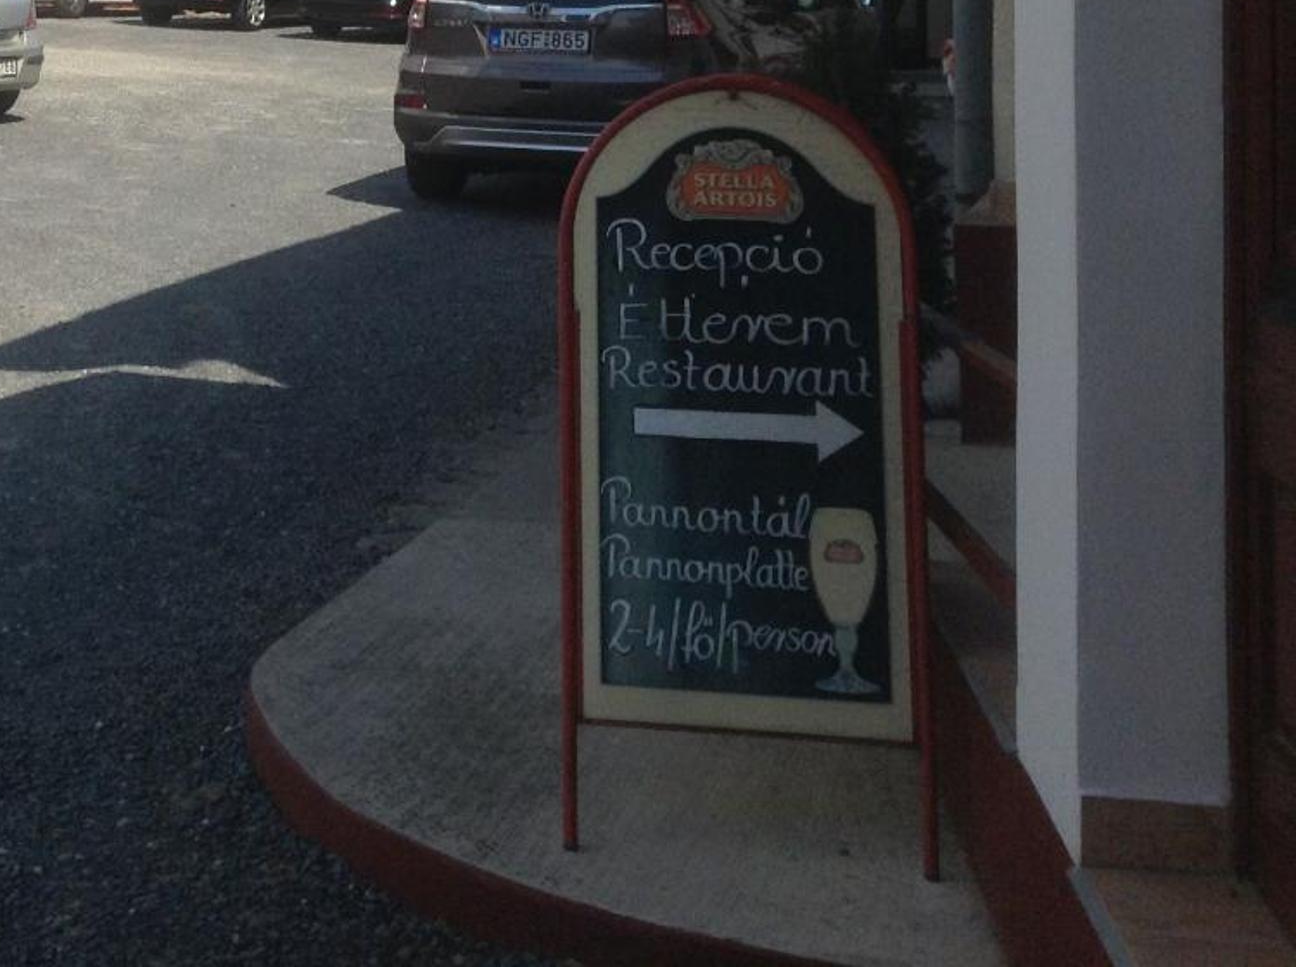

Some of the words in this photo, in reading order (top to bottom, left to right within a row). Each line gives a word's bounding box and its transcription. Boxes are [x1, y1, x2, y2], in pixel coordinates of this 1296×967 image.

[693, 172, 775, 190] STELLA
[693, 191, 778, 208] ARTOIS
[606, 217, 824, 288] Recepció
[601, 345, 875, 398] Restaurant
[601, 476, 812, 540] Pannontál
[600, 534, 811, 600] Pannonplatte
